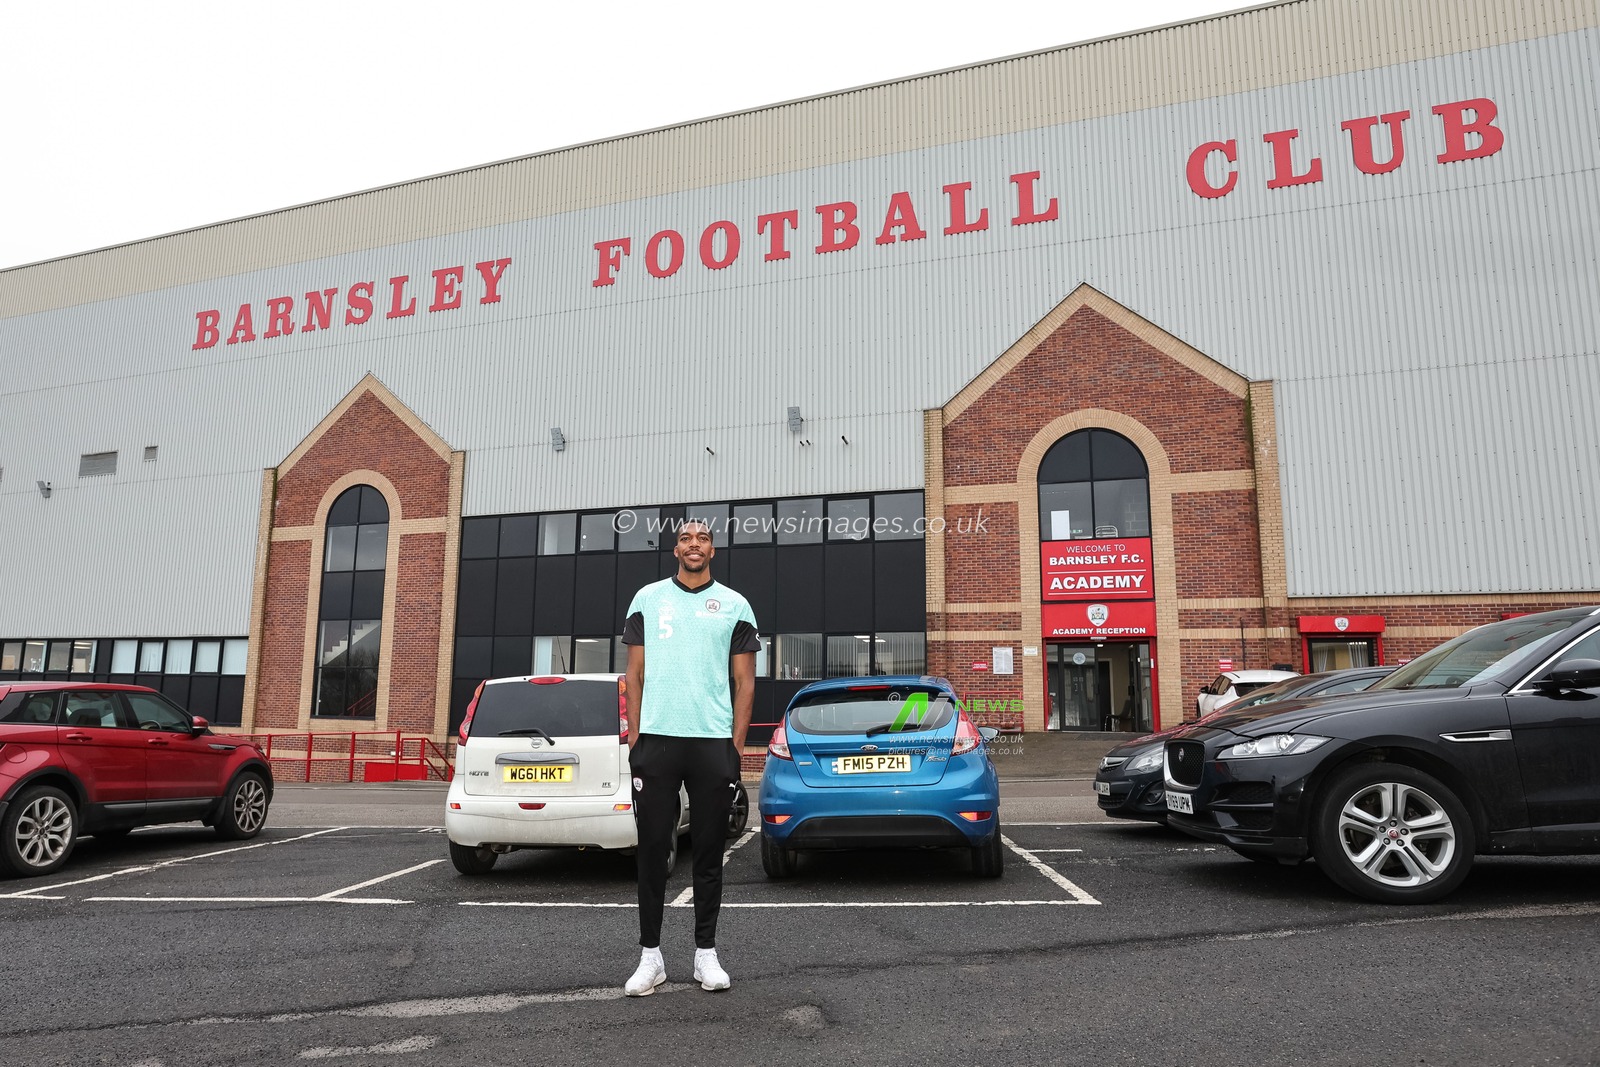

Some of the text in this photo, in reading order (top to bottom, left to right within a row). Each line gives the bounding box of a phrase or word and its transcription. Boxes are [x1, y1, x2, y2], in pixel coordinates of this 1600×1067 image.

[192, 97, 1505, 351] BARNSLEY FOOTBALL CLUB
[1066, 543, 1126, 553] WELCOME TO
[1049, 553, 1145, 566] BARNSLEY F.C.
[1050, 575, 1145, 590] ACADEMY
[658, 615, 673, 639] 5
[1096, 627, 1146, 635] RECEPTION
[843, 757, 905, 771] FM15 PZH
[510, 767, 565, 780] WG61 HKT
